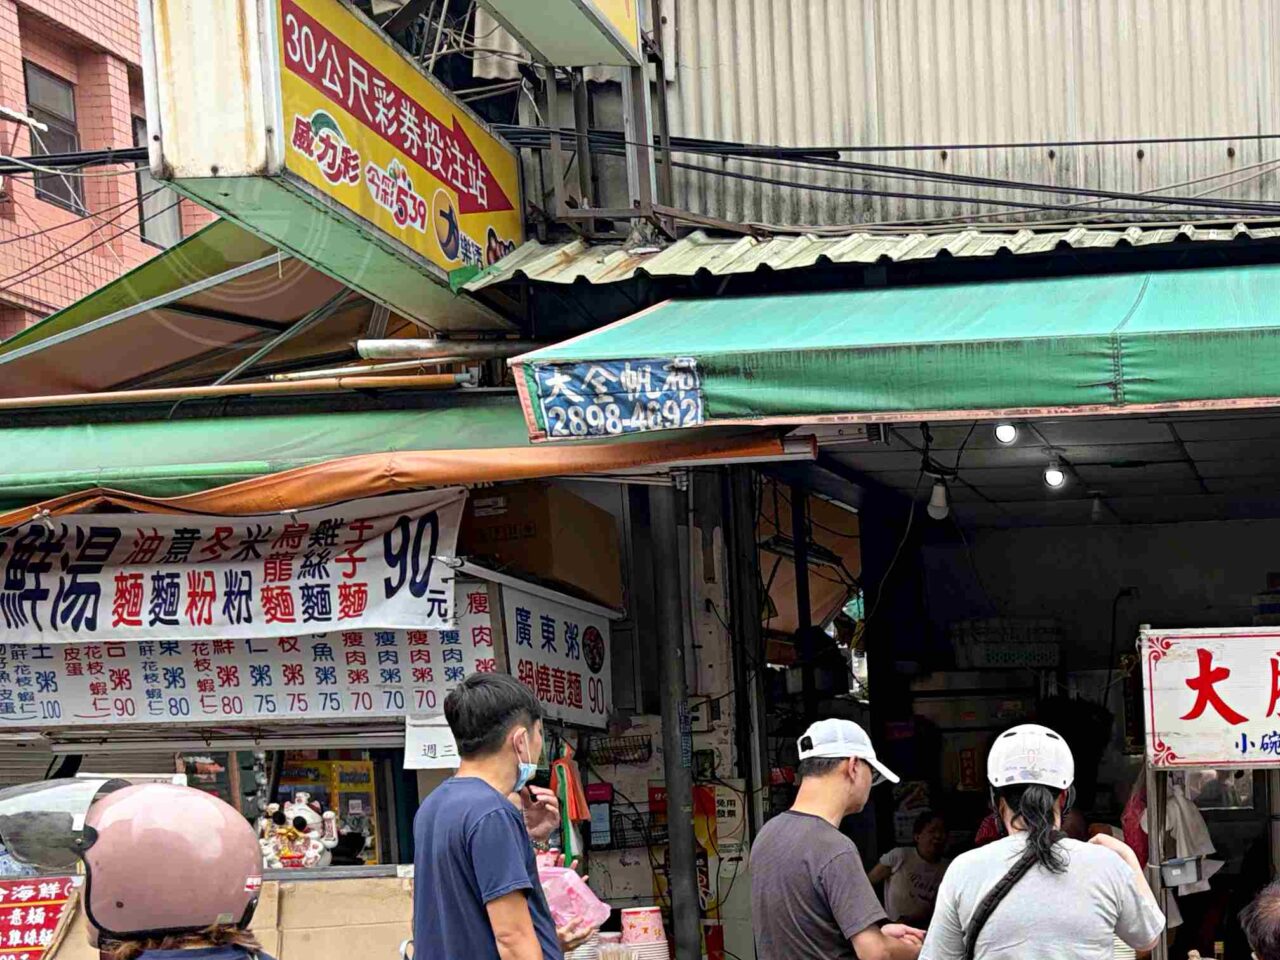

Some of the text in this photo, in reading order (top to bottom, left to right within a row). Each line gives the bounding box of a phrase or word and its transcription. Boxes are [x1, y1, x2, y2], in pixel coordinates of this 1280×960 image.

[286, 13, 488, 209] 30公尺彩券投注站
[0, 523, 121, 632] 鮮湯
[515, 605, 580, 660] 廣東粥
[311, 634, 341, 712] 魚粥 75
[253, 694, 277, 713] 75
[286, 692, 309, 712] 75
[350, 691, 374, 711] 70
[382, 690, 405, 710] 70
[414, 689, 437, 709] 70
[588, 676, 605, 715] 90
[39, 700, 62, 719] 100
[113, 698, 136, 717] 90
[168, 697, 190, 717] 80
[221, 696, 244, 716] 80
